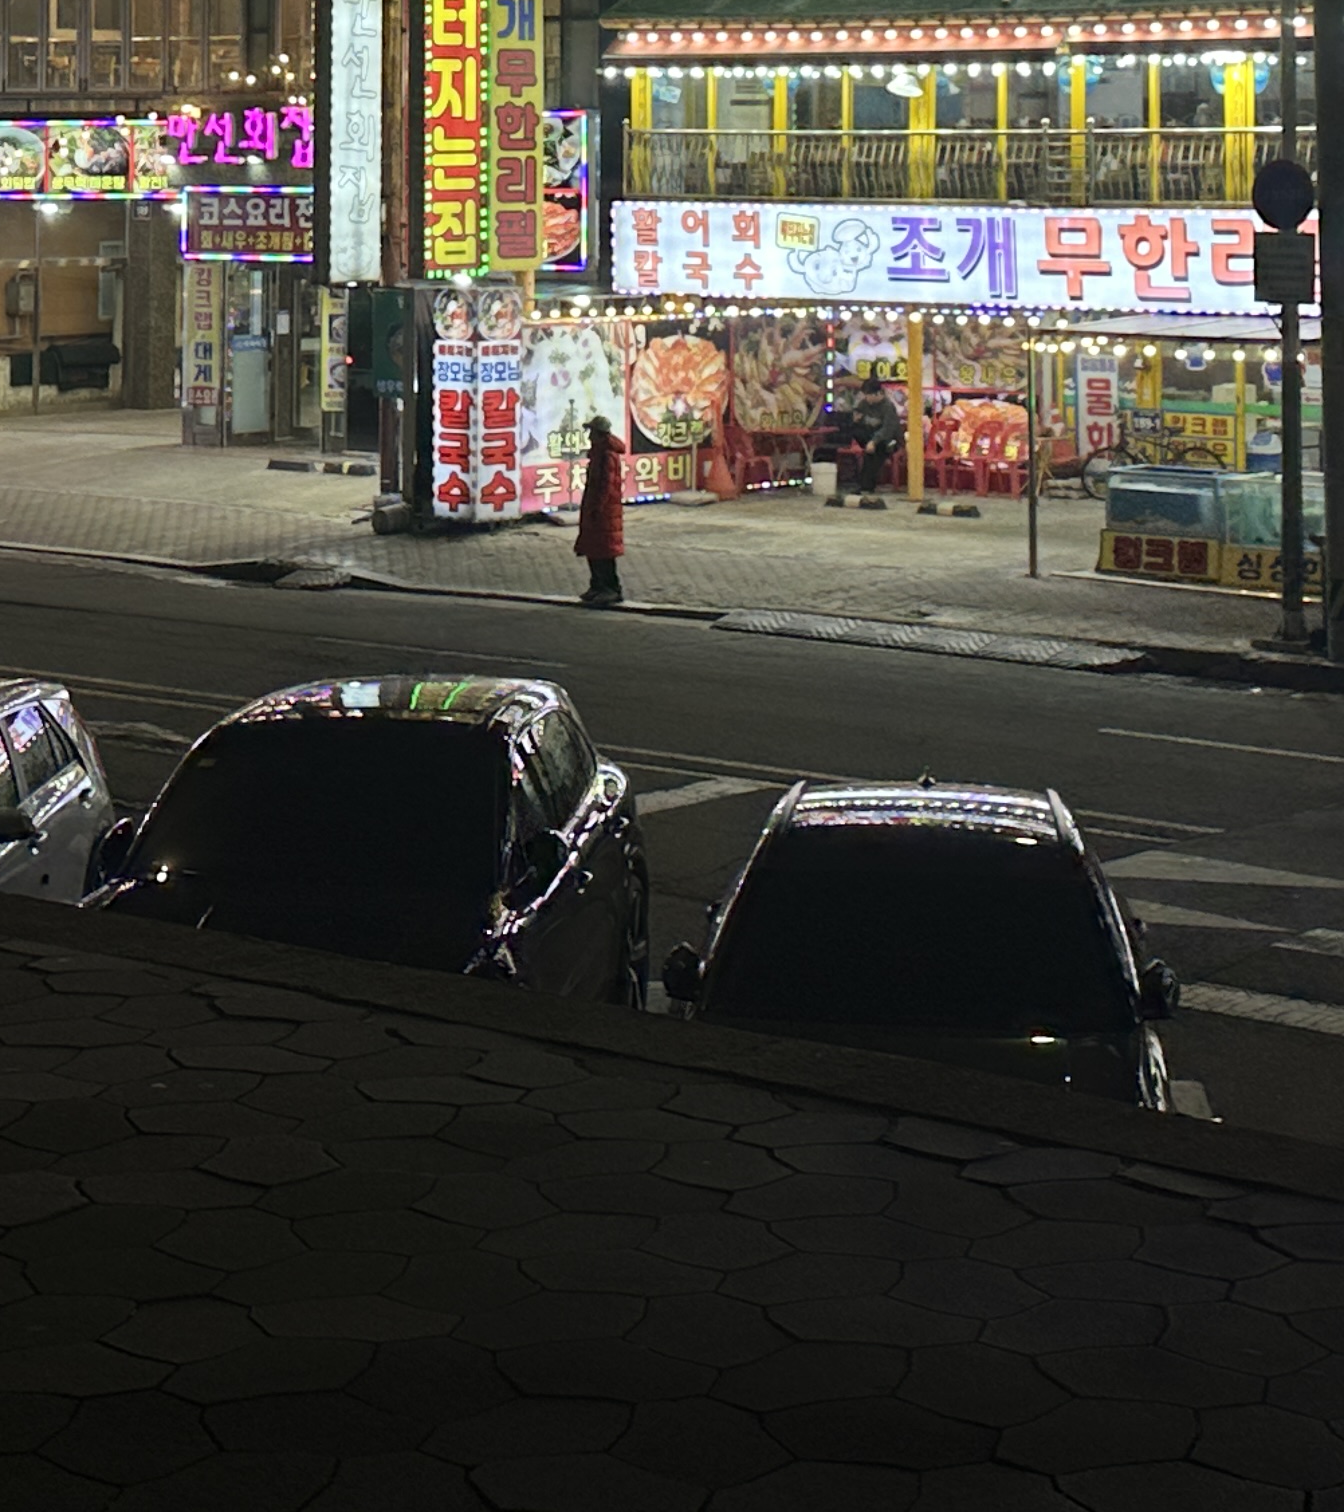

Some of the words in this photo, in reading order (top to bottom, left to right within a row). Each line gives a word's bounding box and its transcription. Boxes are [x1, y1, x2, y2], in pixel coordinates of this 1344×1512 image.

[167, 105, 314, 168] 만선회집
[494, 48, 539, 260] 무한리필
[199, 197, 292, 227] 코스요리
[631, 209, 761, 248] 활어회
[631, 249, 763, 290] 칼국수
[886, 215, 1018, 299] 조개
[437, 361, 477, 383] 장모님
[480, 361, 522, 383] 장모님
[1085, 377, 1114, 459] 물회
[437, 388, 474, 513] 칼국수
[479, 388, 521, 513] 칼국수
